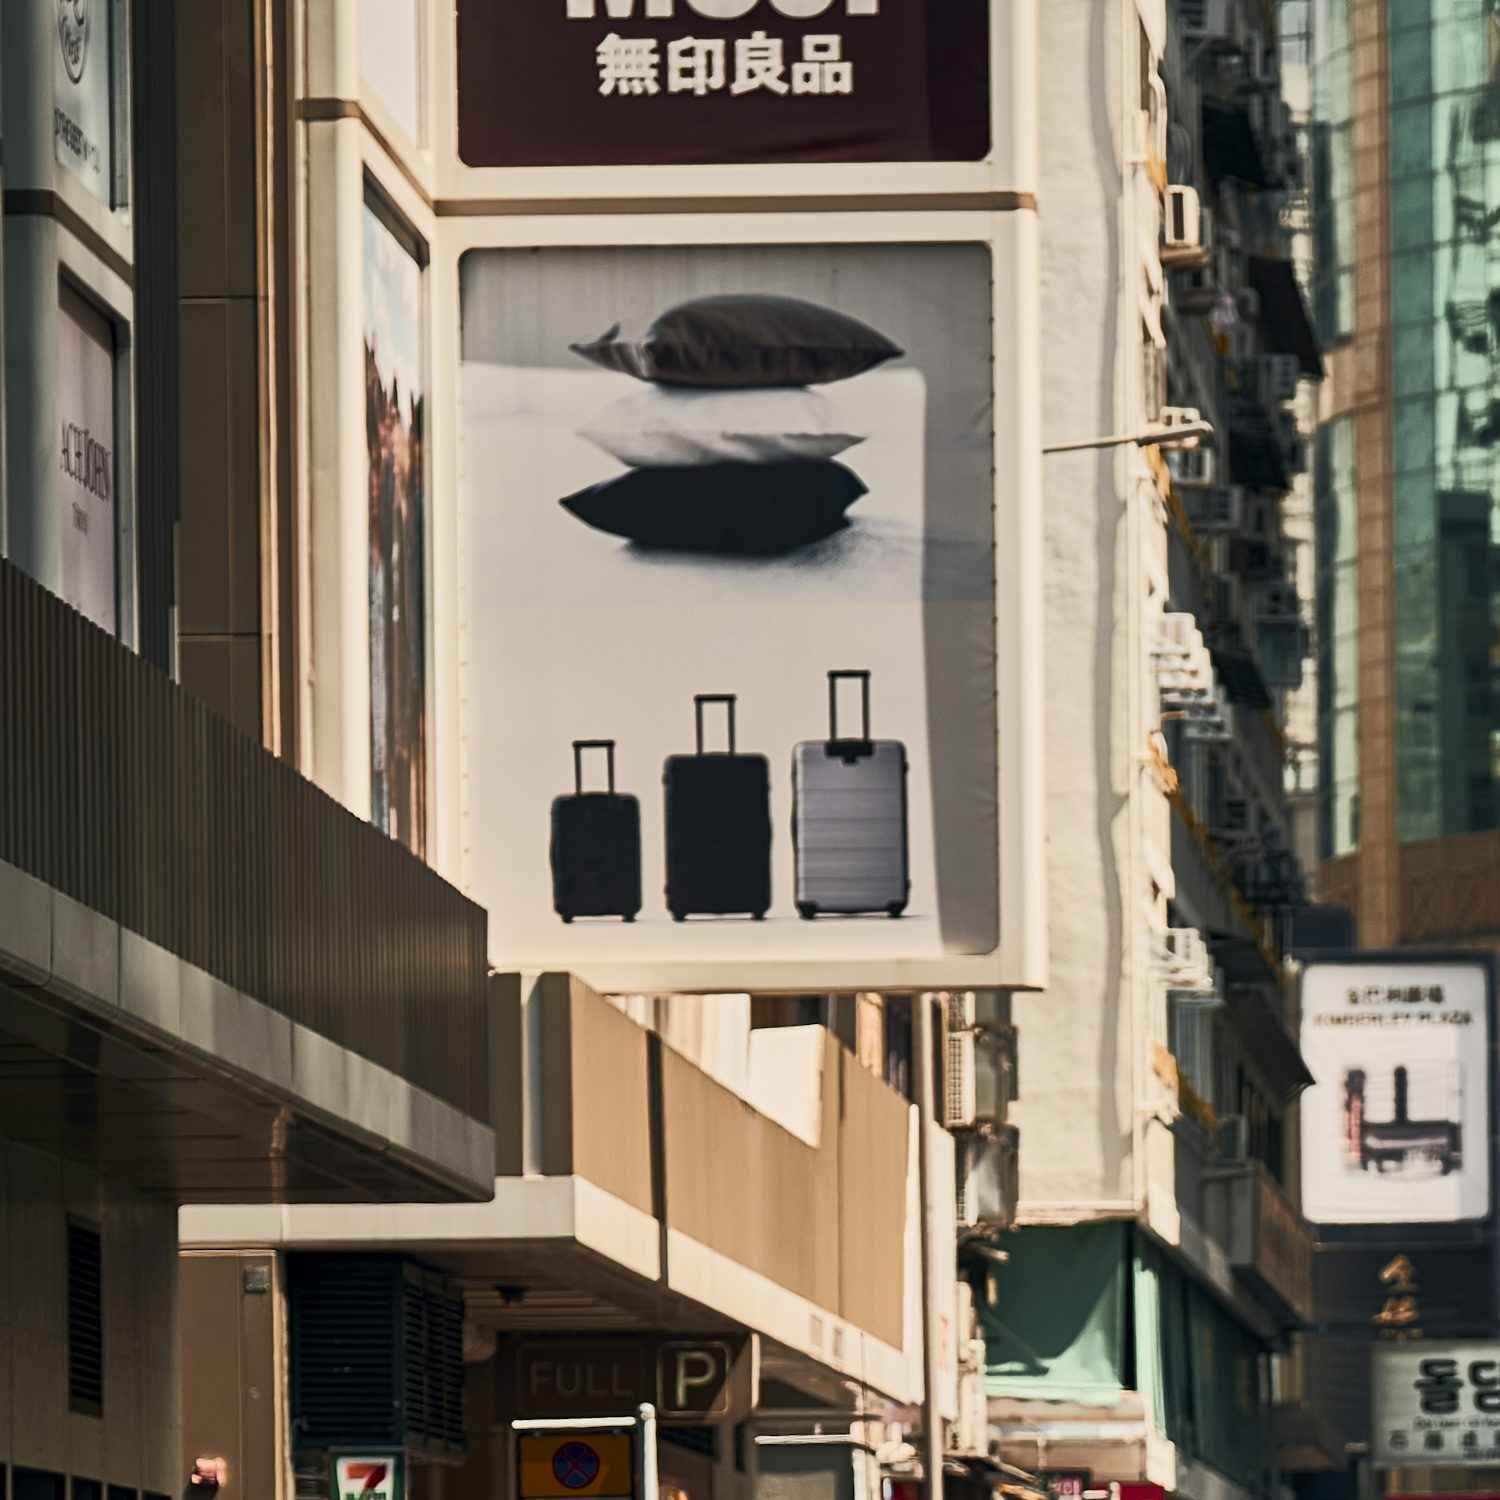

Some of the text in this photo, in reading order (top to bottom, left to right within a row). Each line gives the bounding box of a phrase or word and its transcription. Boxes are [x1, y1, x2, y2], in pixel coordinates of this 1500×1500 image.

[595, 30, 853, 96] 無印良品
[529, 1351, 717, 1408] FULL P
